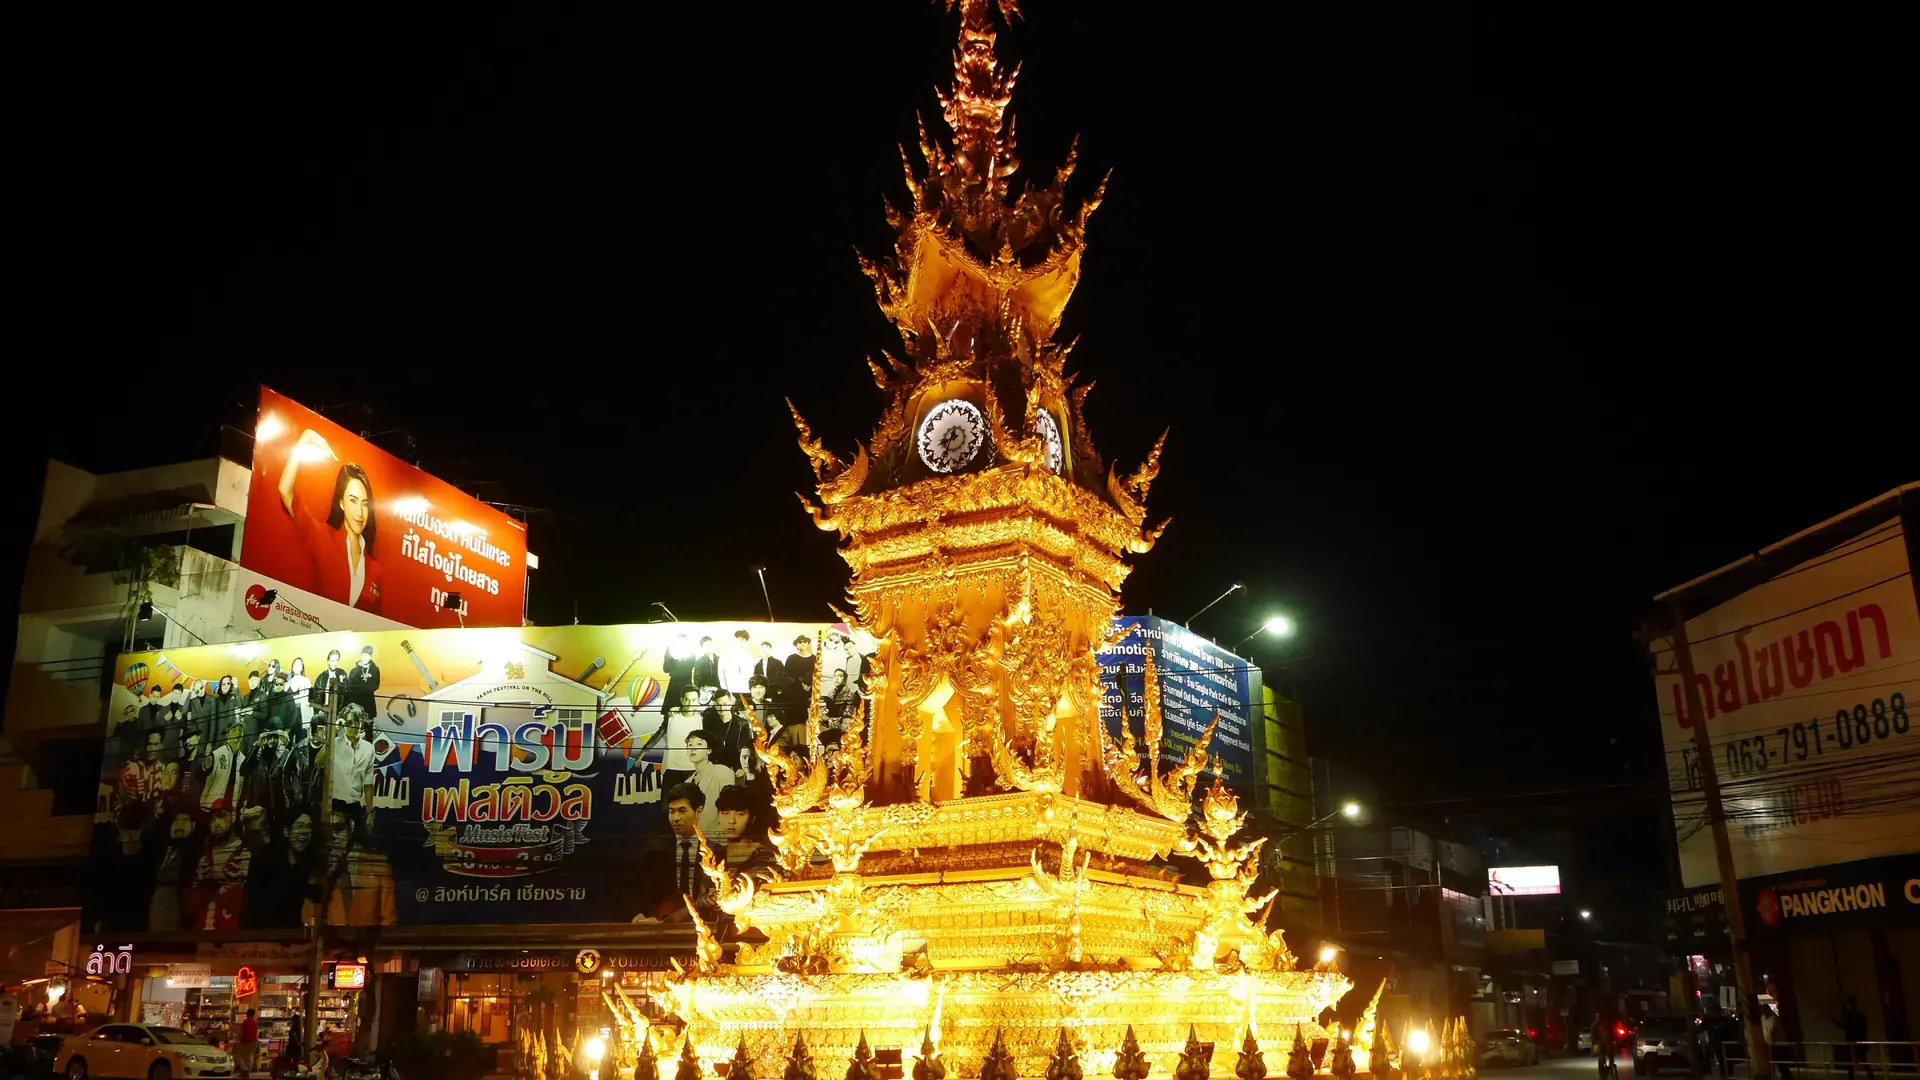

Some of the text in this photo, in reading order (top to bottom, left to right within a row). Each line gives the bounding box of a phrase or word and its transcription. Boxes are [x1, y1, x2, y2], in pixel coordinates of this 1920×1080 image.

[275, 602, 320, 624] airasia.com
[476, 689, 493, 700] FARM
[493, 684, 520, 693] FESTIVAL
[531, 687, 542, 695] THE
[542, 691, 553, 704] HILL
[1209, 687, 1218, 700] Park
[427, 704, 597, 773] ฟาร์ม
[1725, 692, 1910, 779] 063-791-0888
[421, 772, 593, 823] เฟสติวัล
[415, 887, 429, 902] @
[516, 884, 587, 901] เชียงราย
[1780, 882, 1887, 918] PANGKHON
[86, 944, 133, 975] ลำดี
